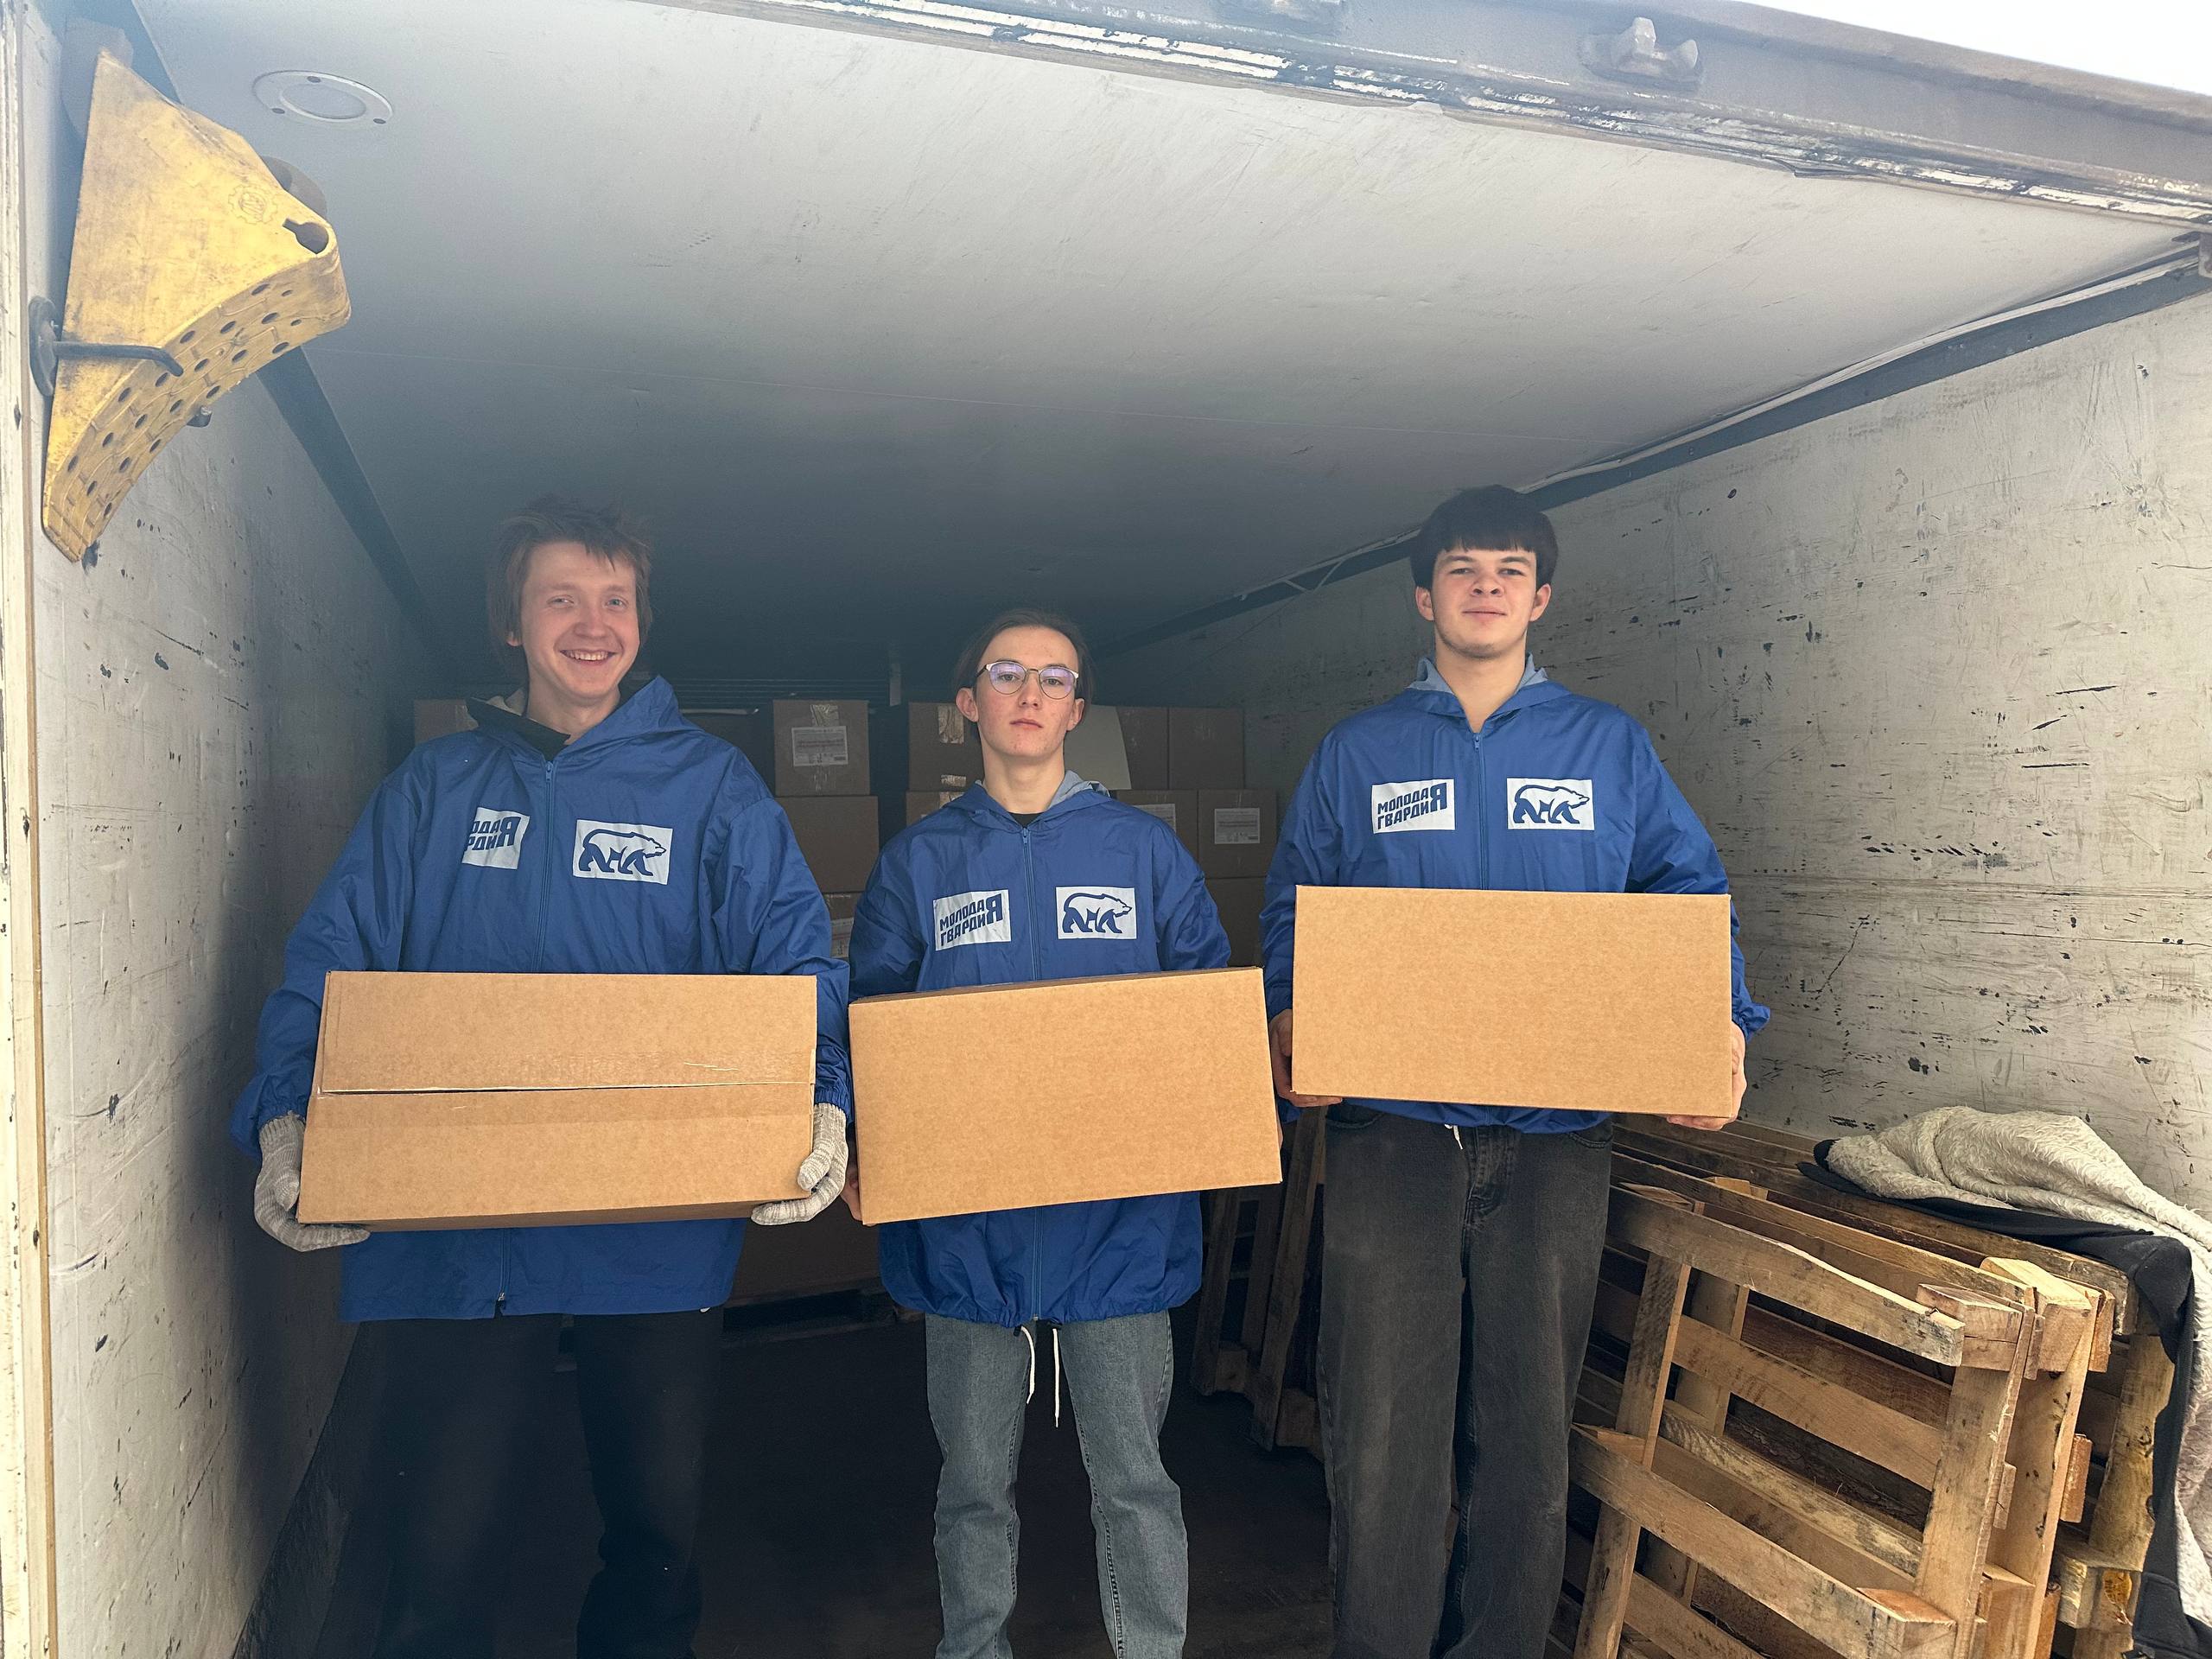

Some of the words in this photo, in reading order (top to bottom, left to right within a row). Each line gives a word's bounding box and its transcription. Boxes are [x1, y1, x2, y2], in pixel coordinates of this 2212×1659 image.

[1377, 783, 1447, 815] МОЛОДАЯ
[1377, 783, 1447, 830] ГВАРДИЯ
[939, 893, 1003, 931] МОЛОДАЯ
[940, 893, 1003, 946] ГВАРДИЯ
